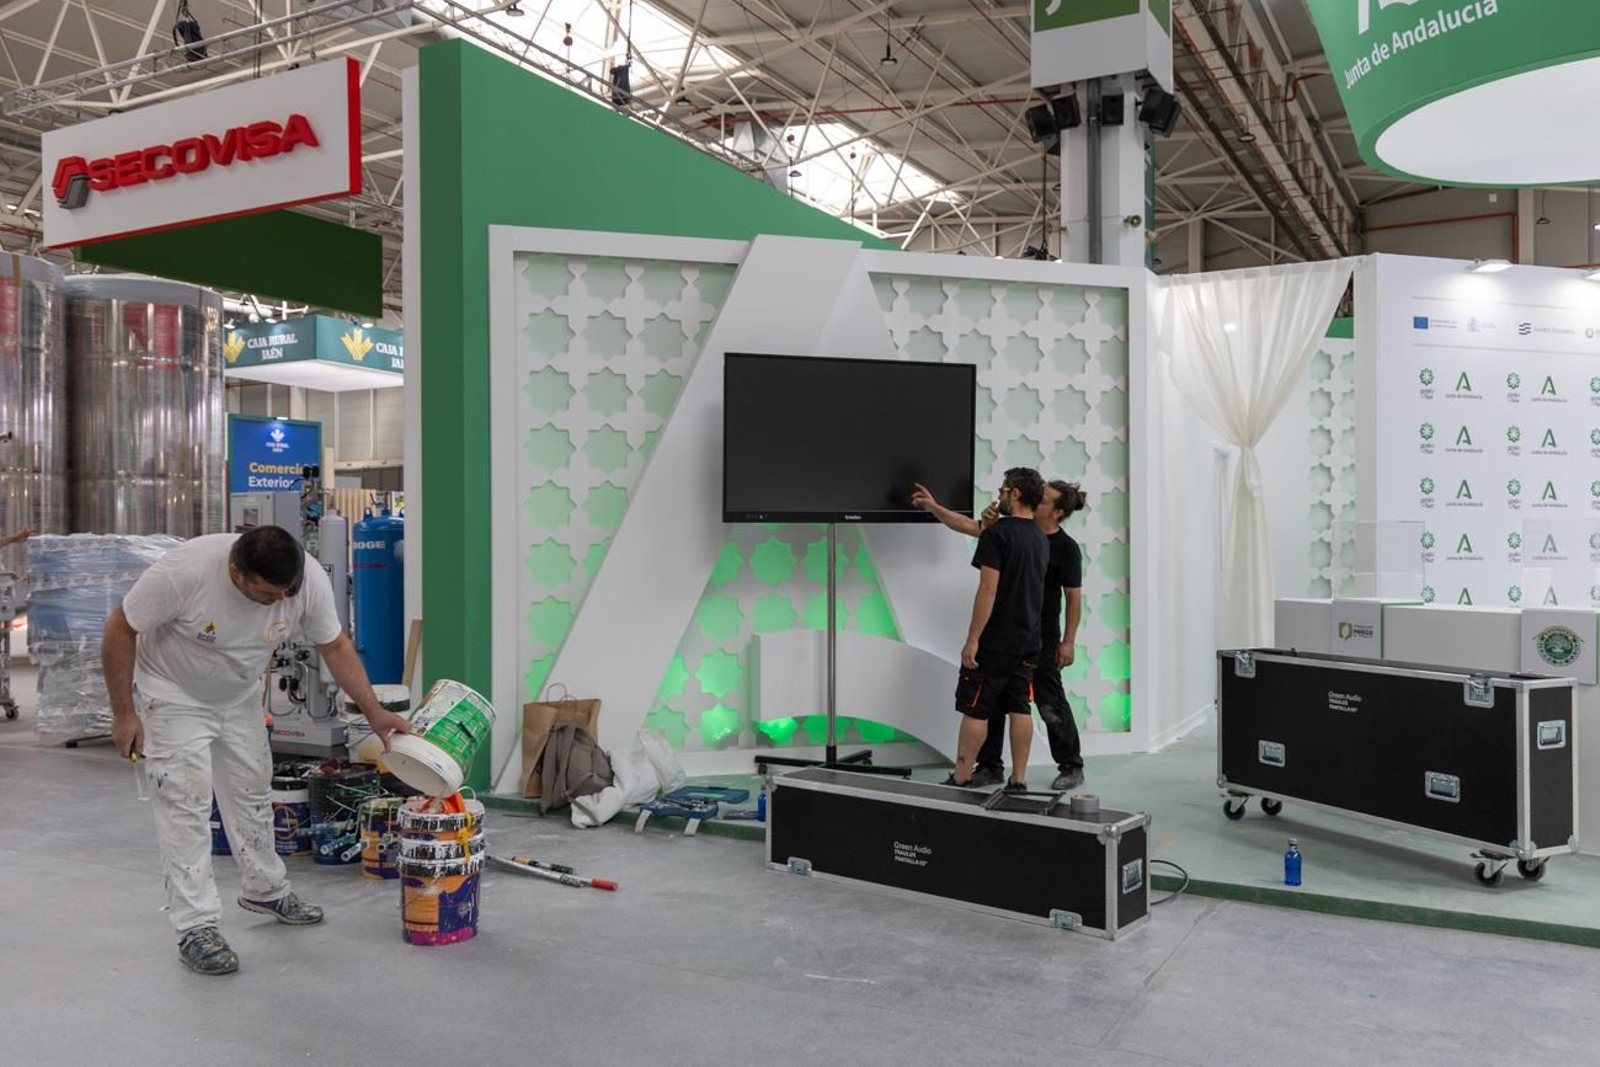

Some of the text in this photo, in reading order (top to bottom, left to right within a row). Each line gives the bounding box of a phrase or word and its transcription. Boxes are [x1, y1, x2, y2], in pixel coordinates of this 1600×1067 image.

[1343, 57, 1371, 89] Junta
[1371, 42, 1390, 66] de
[88, 113, 320, 192] SECOVISA
[249, 462, 304, 475] Comerci
